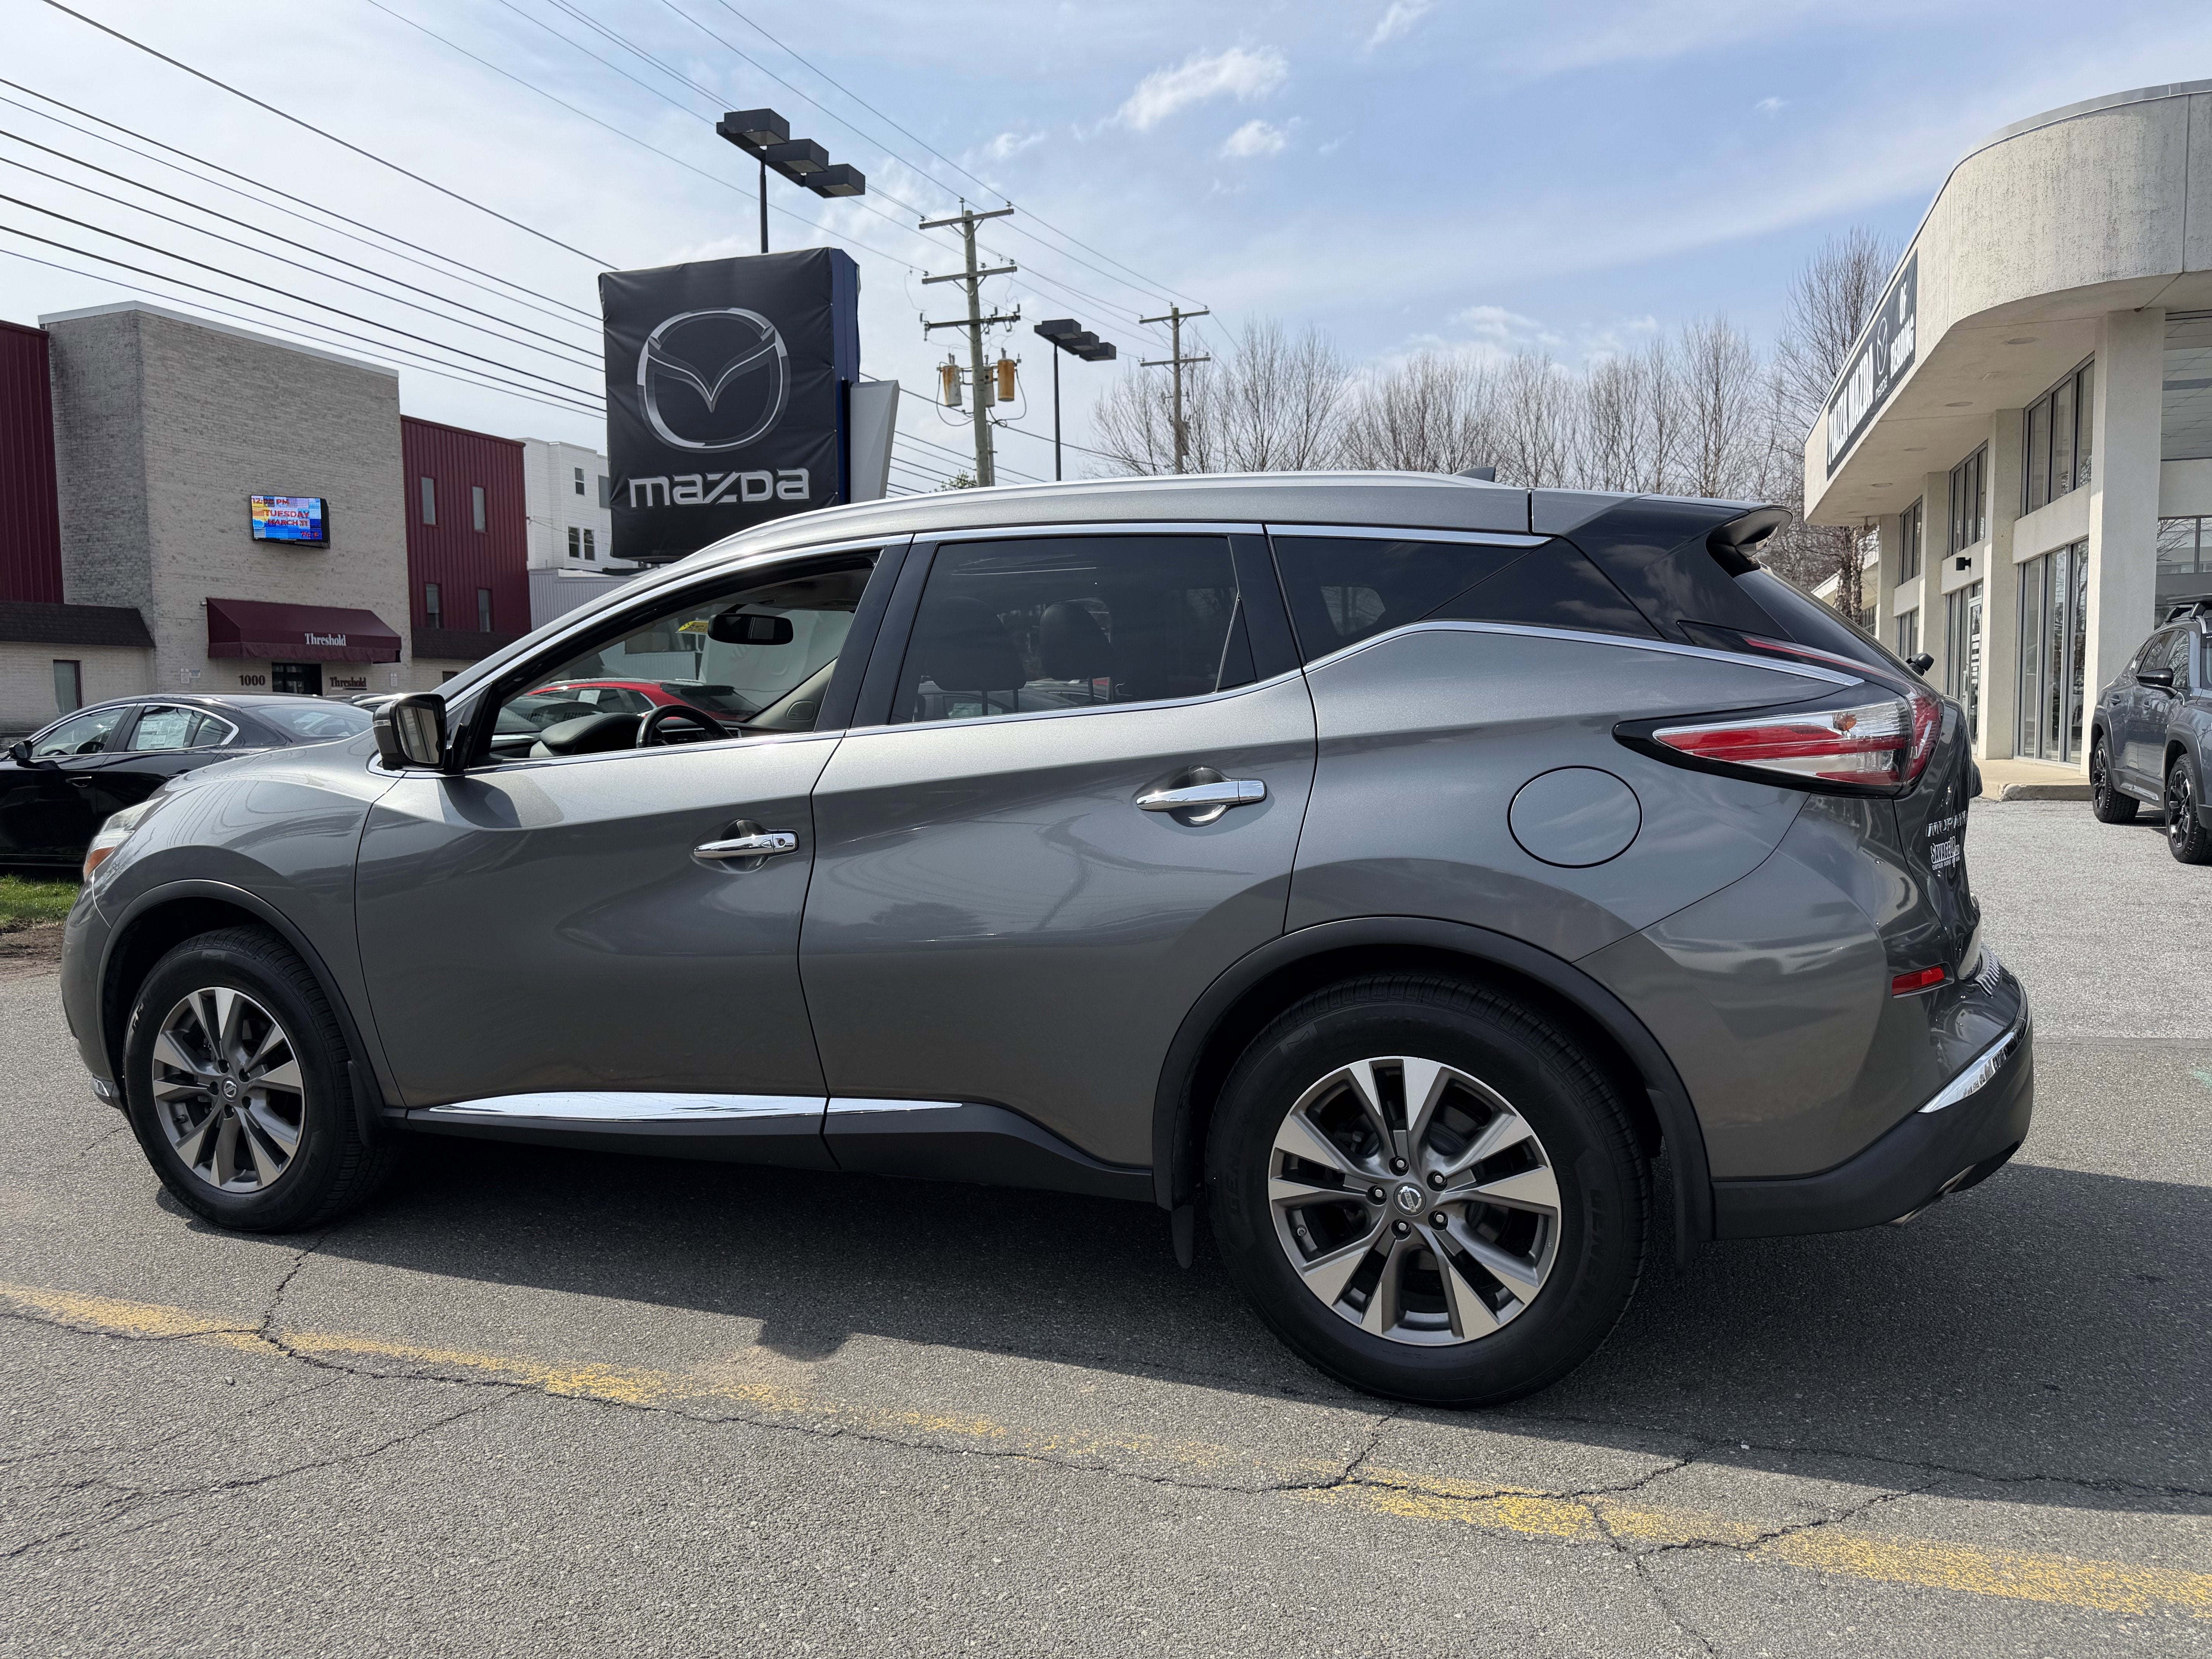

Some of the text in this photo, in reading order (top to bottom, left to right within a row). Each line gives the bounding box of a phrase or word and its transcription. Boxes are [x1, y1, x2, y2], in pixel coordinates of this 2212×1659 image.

[1899, 281, 1907, 325] OF
[1890, 313, 1914, 379] READING
[1828, 342, 1873, 465] PIAZZA MAZDA
[628, 467, 810, 508] mazda
[264, 510, 309, 518] TUESDAY
[305, 633, 347, 646] Threshold
[239, 675, 265, 686] 1000
[330, 677, 366, 687] Threshold
